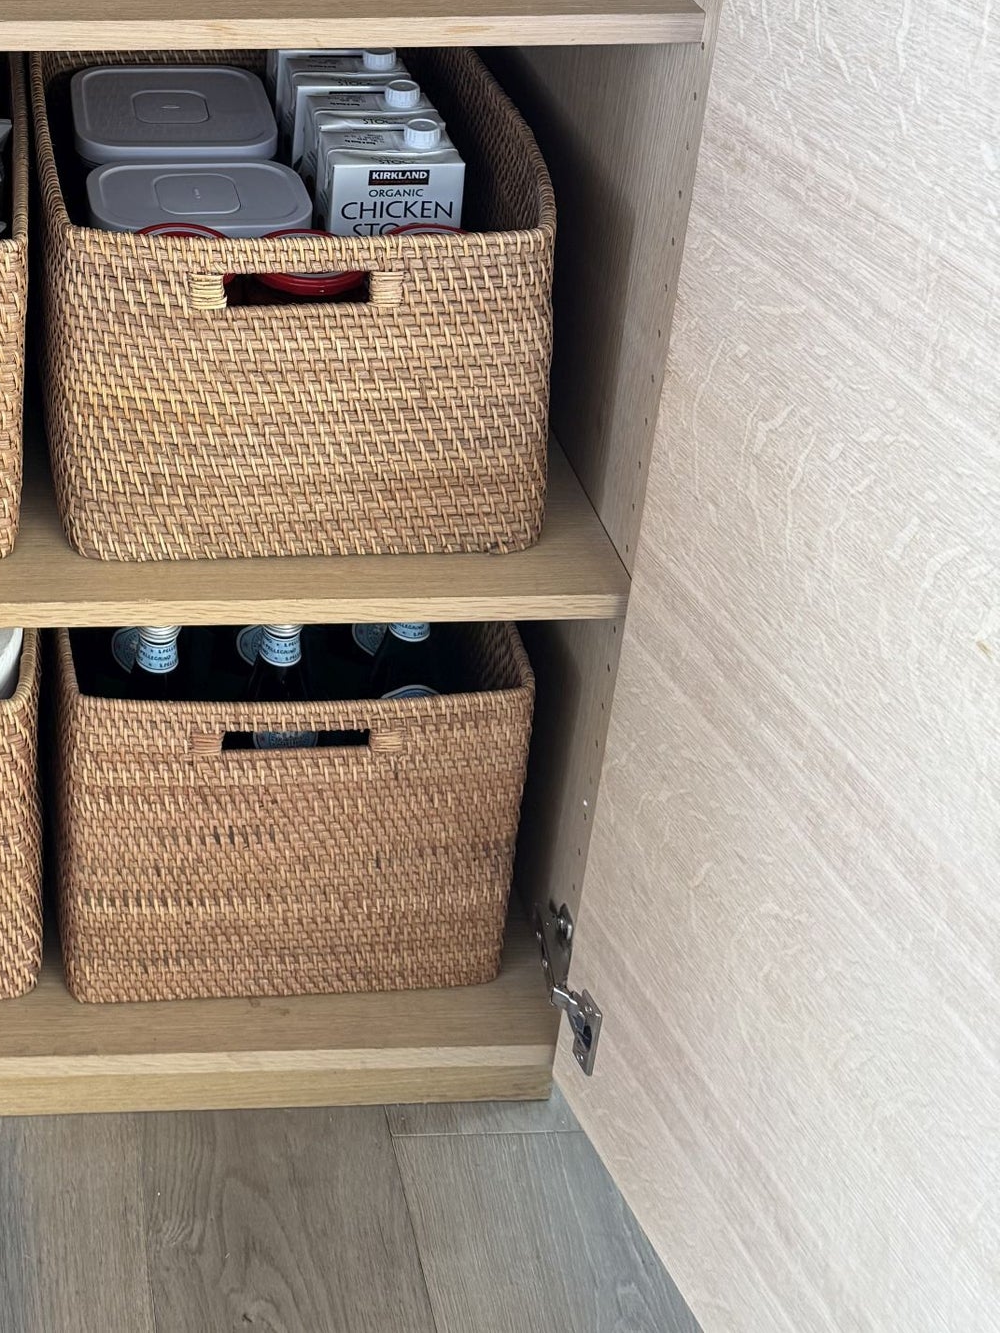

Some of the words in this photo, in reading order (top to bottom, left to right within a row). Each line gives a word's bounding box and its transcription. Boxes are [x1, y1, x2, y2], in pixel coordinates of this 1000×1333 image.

[372, 170, 428, 180] KIRKLAND
[368, 188, 424, 198] ORGANIC
[341, 200, 453, 220] CHICKEN
[353, 223, 400, 237] STO
